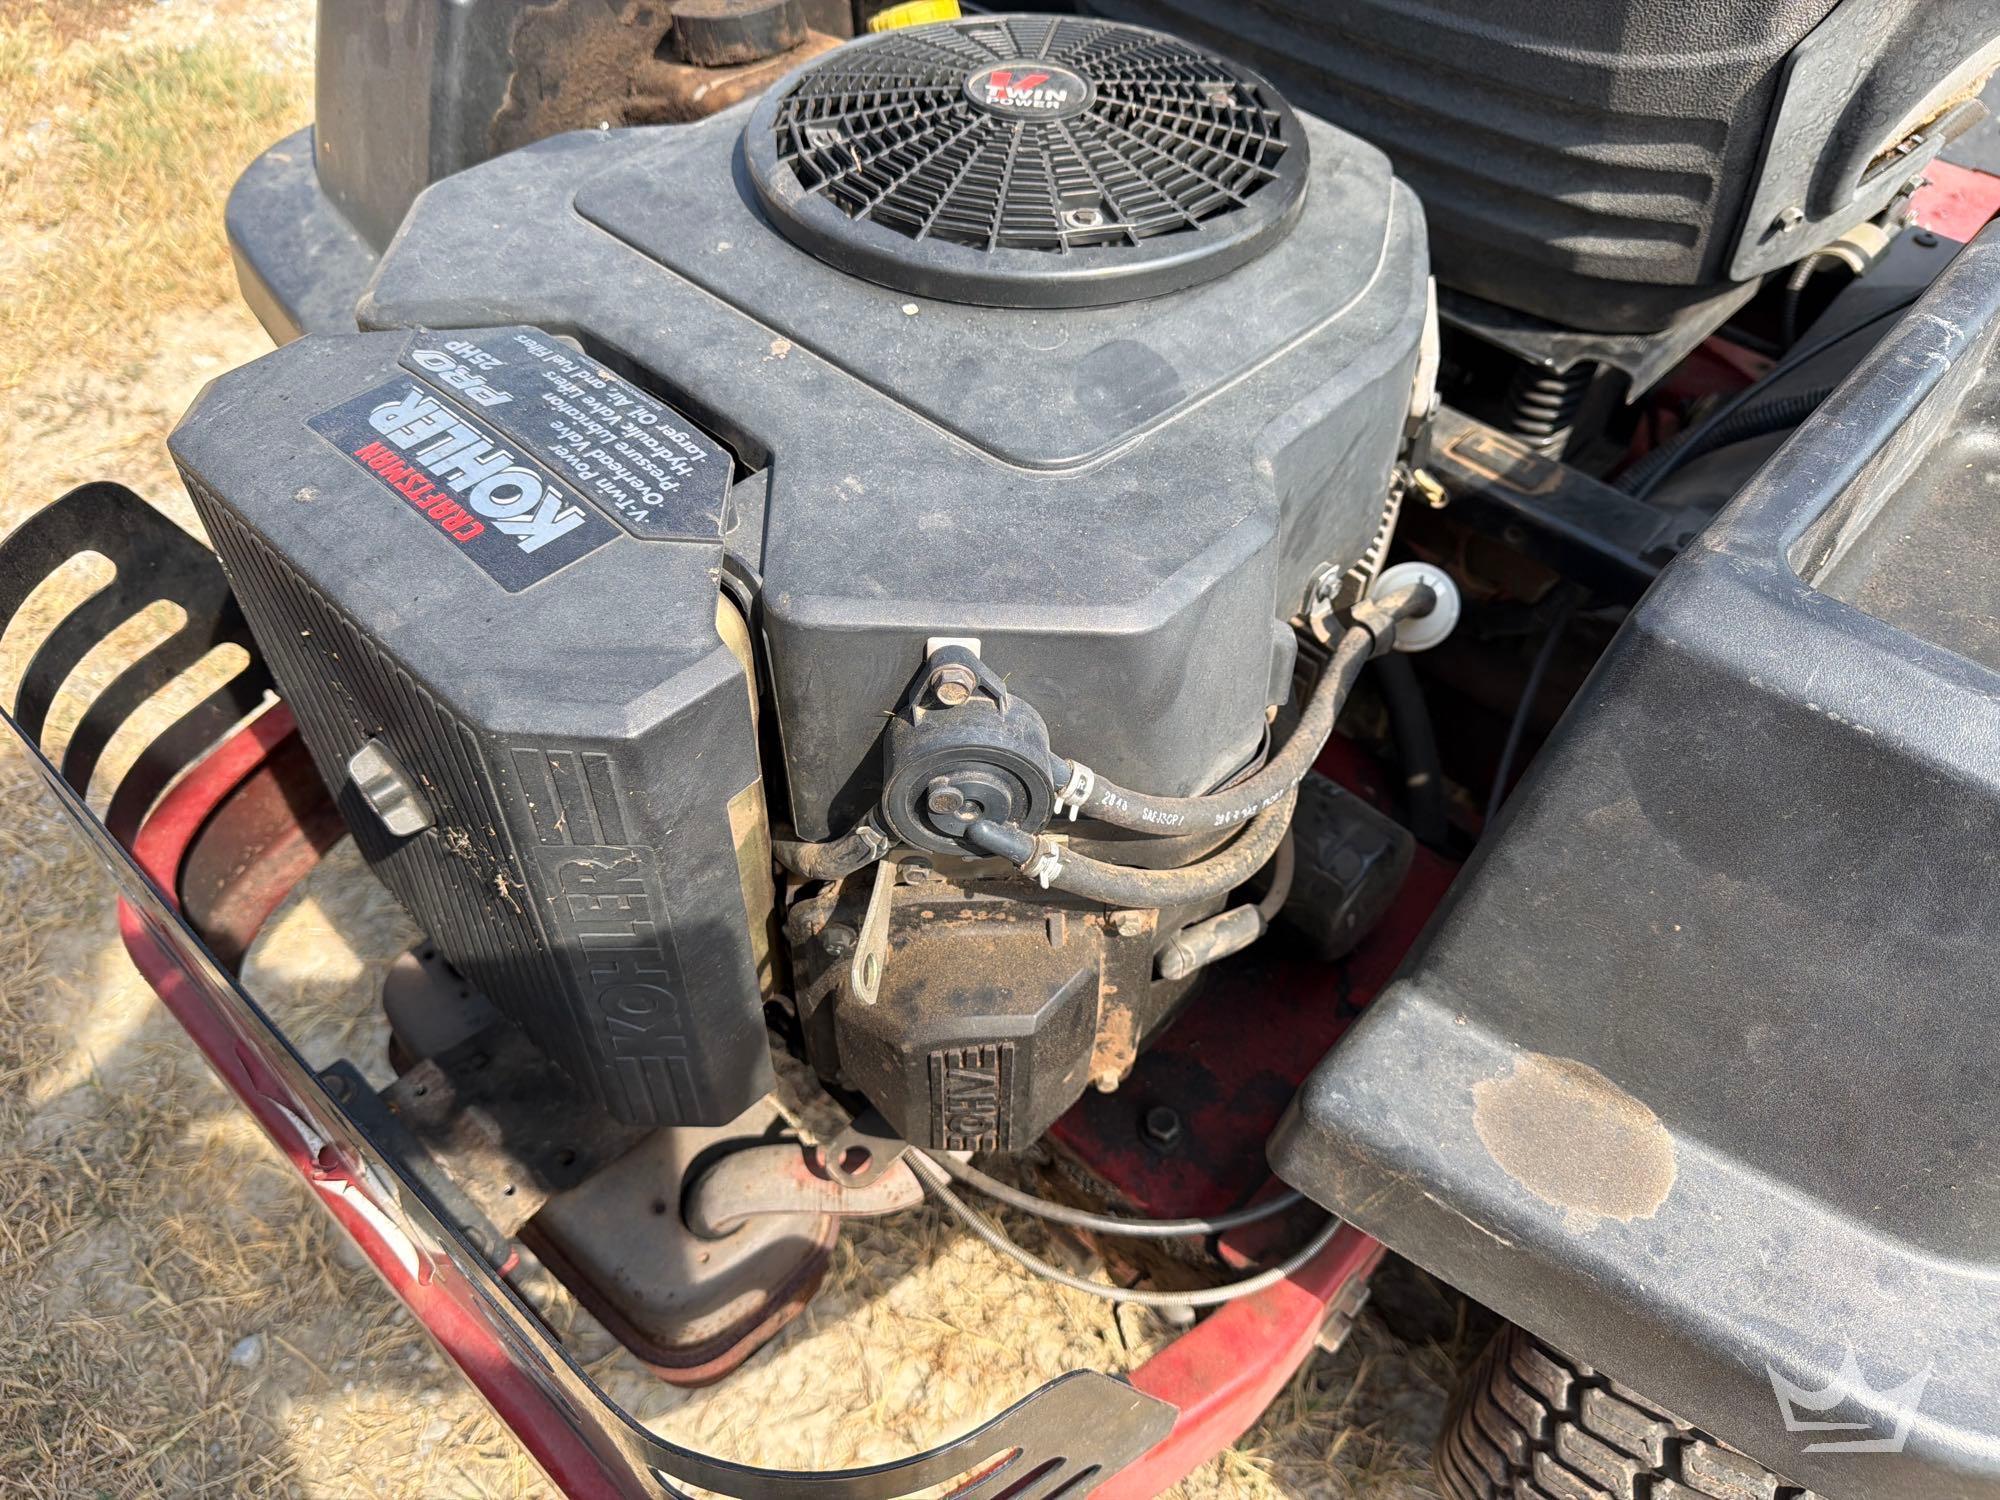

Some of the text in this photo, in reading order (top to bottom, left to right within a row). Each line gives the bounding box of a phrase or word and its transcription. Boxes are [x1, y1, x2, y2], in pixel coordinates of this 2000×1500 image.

[984, 84, 1068, 102] TWIN
[985, 95, 1061, 110] POWER
[444, 341, 505, 370] 25HP
[513, 335, 549, 362] Filters
[543, 354, 580, 373] Fuel
[411, 349, 514, 407] PRO
[542, 370, 586, 399] Lifters
[577, 368, 607, 390] and
[582, 395, 623, 426] Valve
[606, 388, 635, 408] Air,
[627, 404, 658, 425] Oil,
[542, 392, 680, 492] Pressure Lubrication
[621, 422, 694, 476] Hydraulic
[655, 424, 709, 462] Larger
[368, 385, 585, 554] KOHLER
[550, 420, 664, 505] Overhead Valve
[353, 440, 487, 543] CRAFTSMAN
[547, 444, 650, 522] V-Twin Power
[558, 857, 687, 1051] KOHLER
[947, 1068, 998, 1136] OHV
